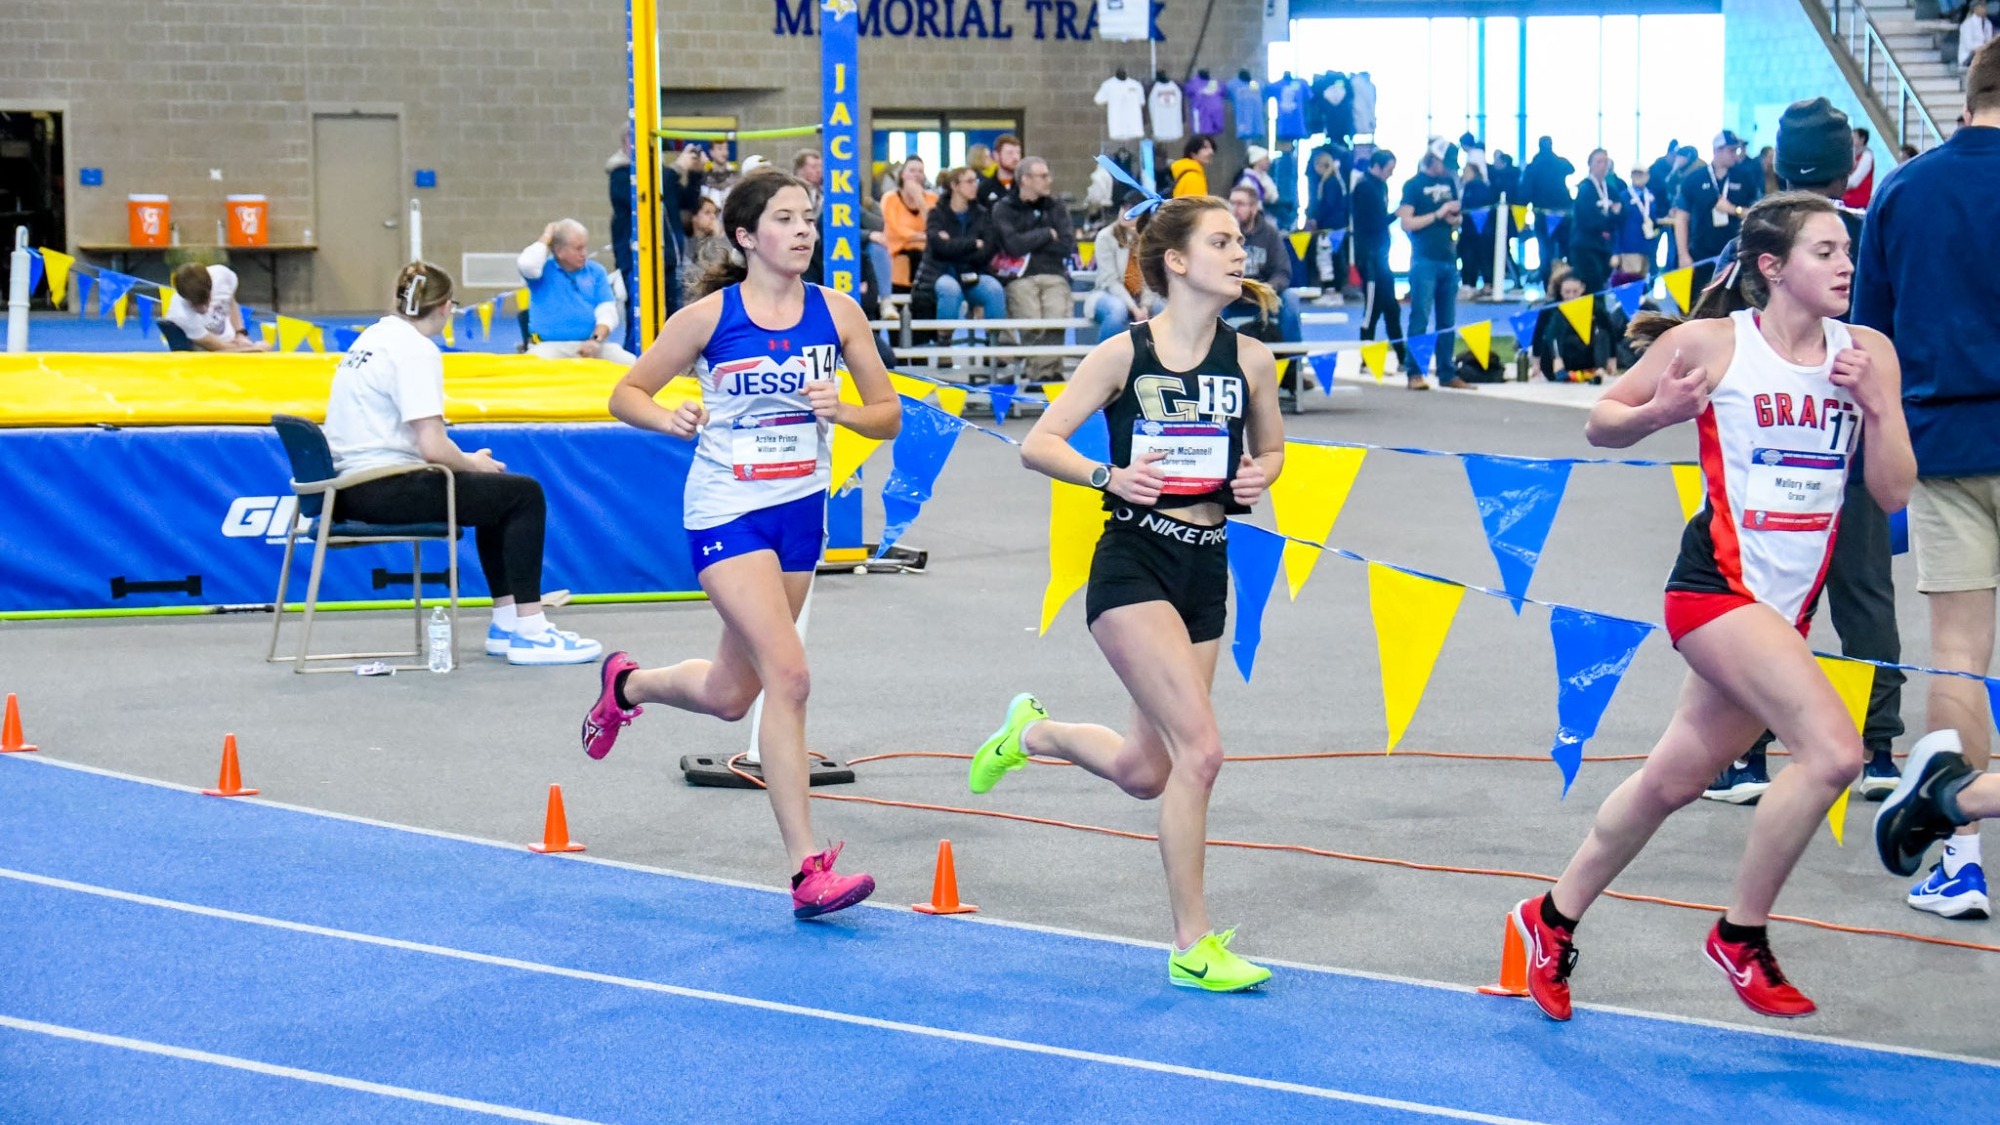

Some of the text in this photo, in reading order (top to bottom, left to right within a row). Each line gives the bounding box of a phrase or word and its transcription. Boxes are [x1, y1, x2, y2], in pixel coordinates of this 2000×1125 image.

[774, 0, 1166, 41] MMORIAL TRAK
[807, 346, 833, 380] 14
[1203, 377, 1237, 414] 15
[1830, 411, 1859, 453] 17
[1177, 446, 1213, 456] McConnell
[1775, 477, 1803, 490] Mallory
[1138, 513, 1201, 545] NIKE
